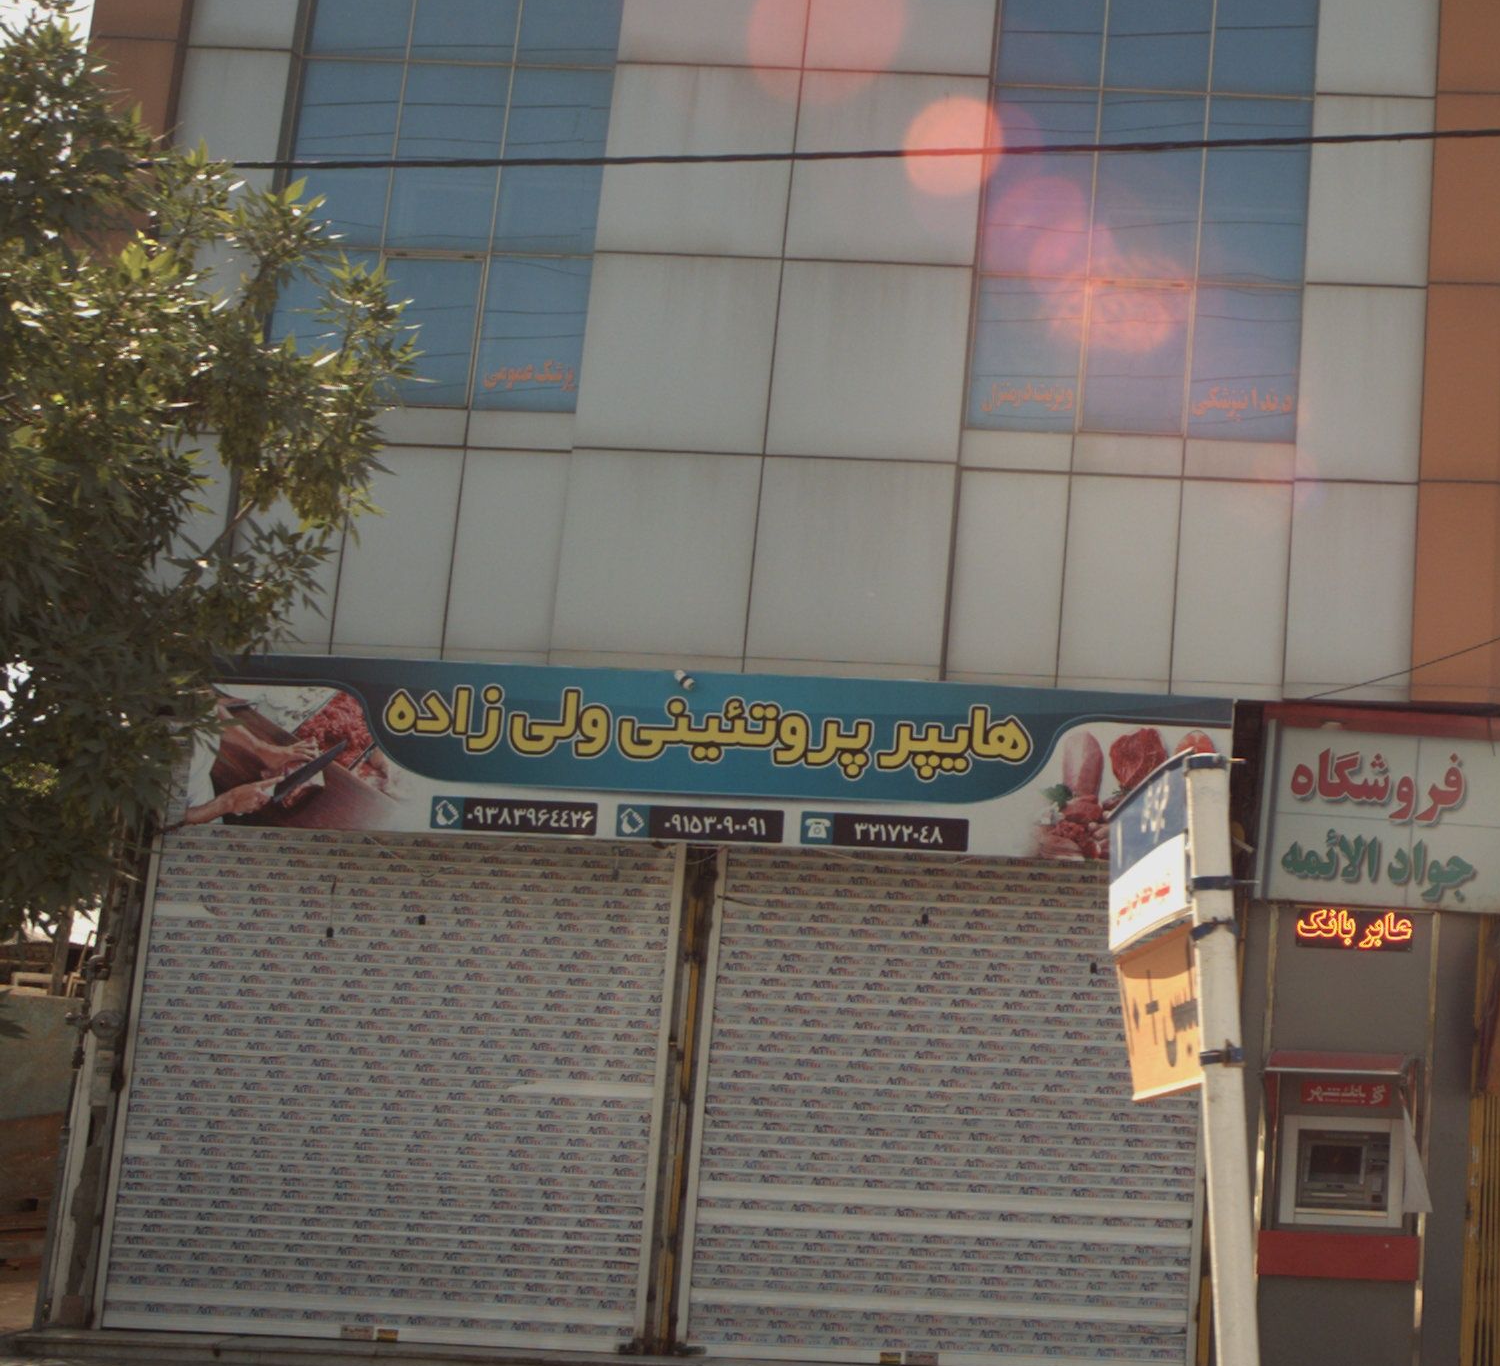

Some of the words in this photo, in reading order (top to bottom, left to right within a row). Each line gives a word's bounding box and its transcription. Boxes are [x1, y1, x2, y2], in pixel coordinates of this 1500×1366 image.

[382, 684, 506, 754] زاده
[508, 687, 613, 759] ولی
[615, 696, 873, 780] پروتئینی
[877, 704, 1032, 782] هایپر
[1289, 746, 1466, 823] فروشگاه
[1281, 828, 1382, 883] الائمه
[1388, 838, 1477, 903] جواد
[1296, 908, 1357, 947] بانک
[1358, 910, 1414, 949] عابر
